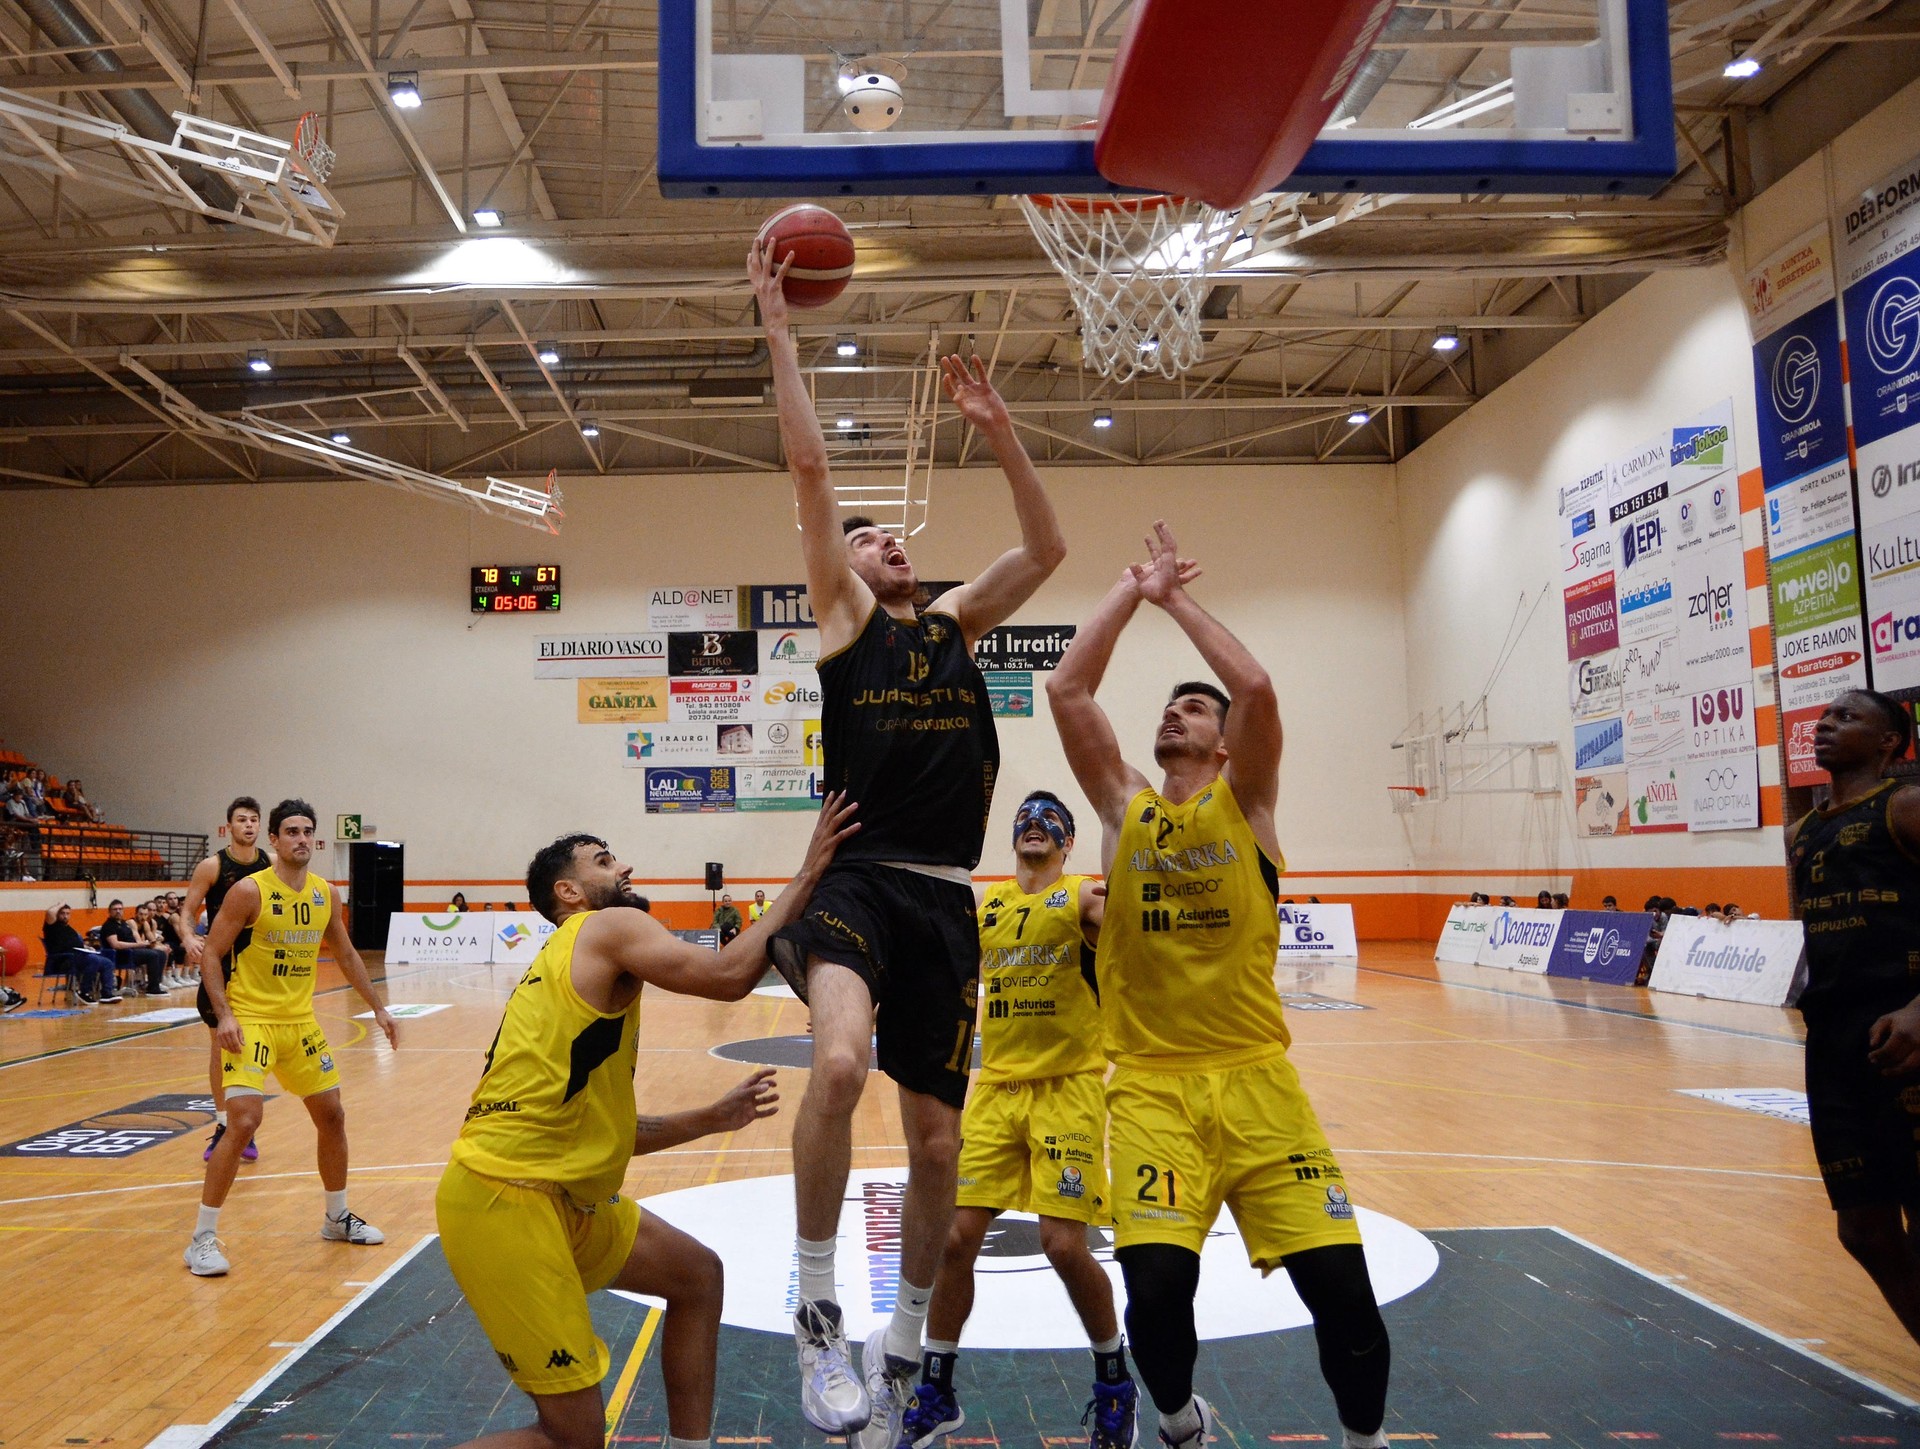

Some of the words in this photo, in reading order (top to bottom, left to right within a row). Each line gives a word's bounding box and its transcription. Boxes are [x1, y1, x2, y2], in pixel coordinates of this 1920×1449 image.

[1781, 247, 1813, 272] AUNTXA
[1777, 257, 1821, 290] ERRETEGIA
[1622, 445, 1665, 478] CARMONA
[1800, 480, 1819, 493] HORTZ
[1821, 469, 1845, 485] KLINIKA
[1614, 503, 1628, 519] 943
[1632, 496, 1644, 510] 151
[1648, 487, 1662, 503] 514
[1802, 506, 1810, 514] Dr.
[1811, 499, 1826, 511] Felipe
[1827, 490, 1847, 504] Sudupe
[1637, 517, 1661, 554] EPI
[481, 569, 498, 583] 78
[512, 575, 520, 586] 4
[537, 567, 556, 582] 67
[479, 596, 487, 608] 4
[495, 595, 536, 610] 05:06
[552, 594, 560, 606] 3
[651, 589, 733, 606] ALD@NET
[1621, 578, 1670, 605] iragaz
[1688, 575, 1733, 624] zaher
[1569, 600, 1613, 628] PASTORKUA
[1793, 592, 1836, 616] AZPEITIA
[1580, 618, 1615, 641] JATETXEA
[1709, 619, 1733, 631] GRUPO
[540, 642, 559, 657] EL
[561, 640, 614, 656] DIARIO
[617, 640, 663, 655] VASCO
[1783, 636, 1809, 658] JOXE
[1813, 624, 1857, 651] RAMON
[691, 657, 732, 667] BETIKO
[1797, 655, 1843, 674] harategia
[589, 692, 657, 709] GAÑETA
[1692, 687, 1743, 727] IOSU
[1694, 725, 1745, 747] OPTIKA
[710, 768, 729, 776] 943
[762, 768, 806, 777] mármoles
[649, 790, 702, 798] NEUMATIKOAK
[650, 779, 677, 790] LAU
[1646, 781, 1677, 803] AÑOTA
[1717, 796, 1750, 810] OPTIKA
[1811, 850, 1825, 883] 2
[1859, 888, 1900, 903] ISB
[292, 902, 310, 926] 10
[1016, 907, 1030, 940] 7
[1177, 907, 1230, 920] Asturias
[1295, 926, 1325, 942] Go
[1507, 921, 1555, 948] CORTEBI
[1808, 917, 1868, 934] GIPUZKOA
[402, 936, 478, 947] INNOVA
[983, 944, 1073, 970] ALIMERKA
[1518, 953, 1540, 966] Azpeitia
[1685, 935, 1767, 973] fundibide
[1003, 975, 1049, 987] OVIEDO
[1013, 998, 1056, 1010] Asturias
[254, 1041, 269, 1068] 10
[1058, 1181, 1085, 1194] OVIEDO
[1137, 1164, 1176, 1207] 21
